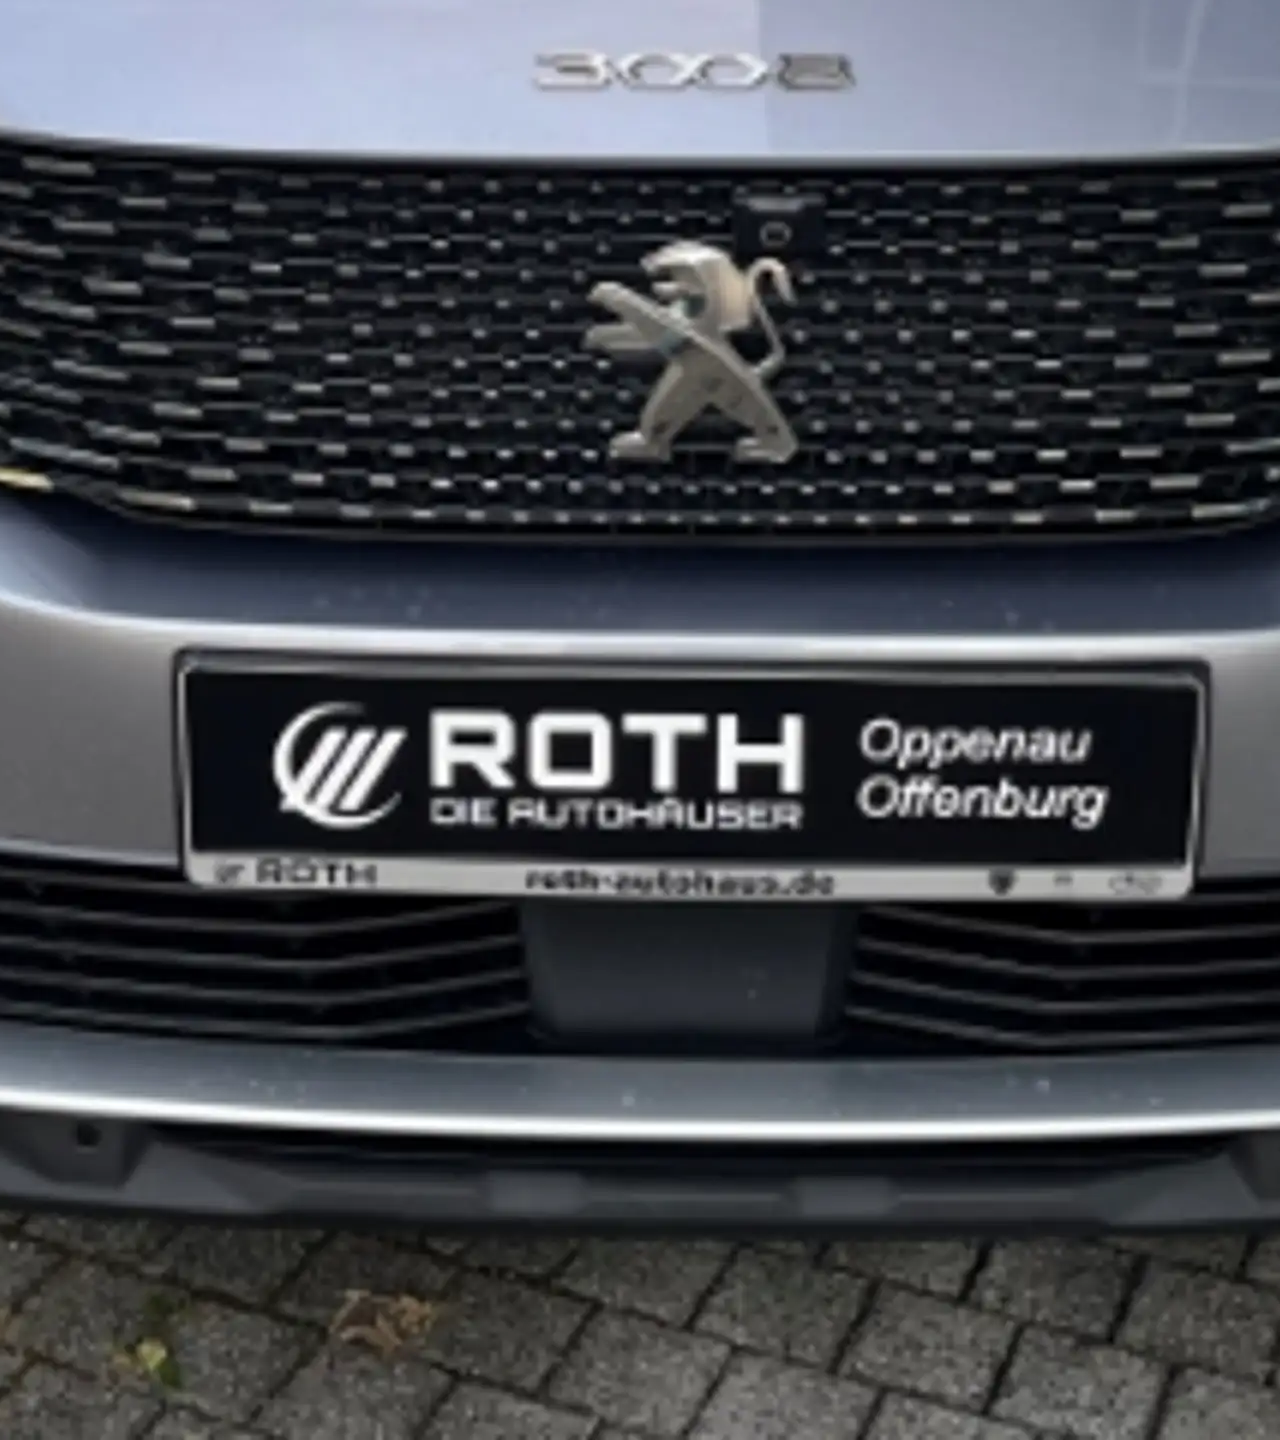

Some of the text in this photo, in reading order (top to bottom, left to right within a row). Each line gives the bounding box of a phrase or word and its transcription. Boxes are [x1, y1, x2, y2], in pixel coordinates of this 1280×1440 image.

[534, 53, 856, 92] 3008
[430, 709, 805, 794] ROTH
[858, 716, 1093, 770] Oppenau
[429, 797, 497, 827] DIE
[856, 774, 1110, 830] Offenburg
[255, 857, 379, 885] ROTH
